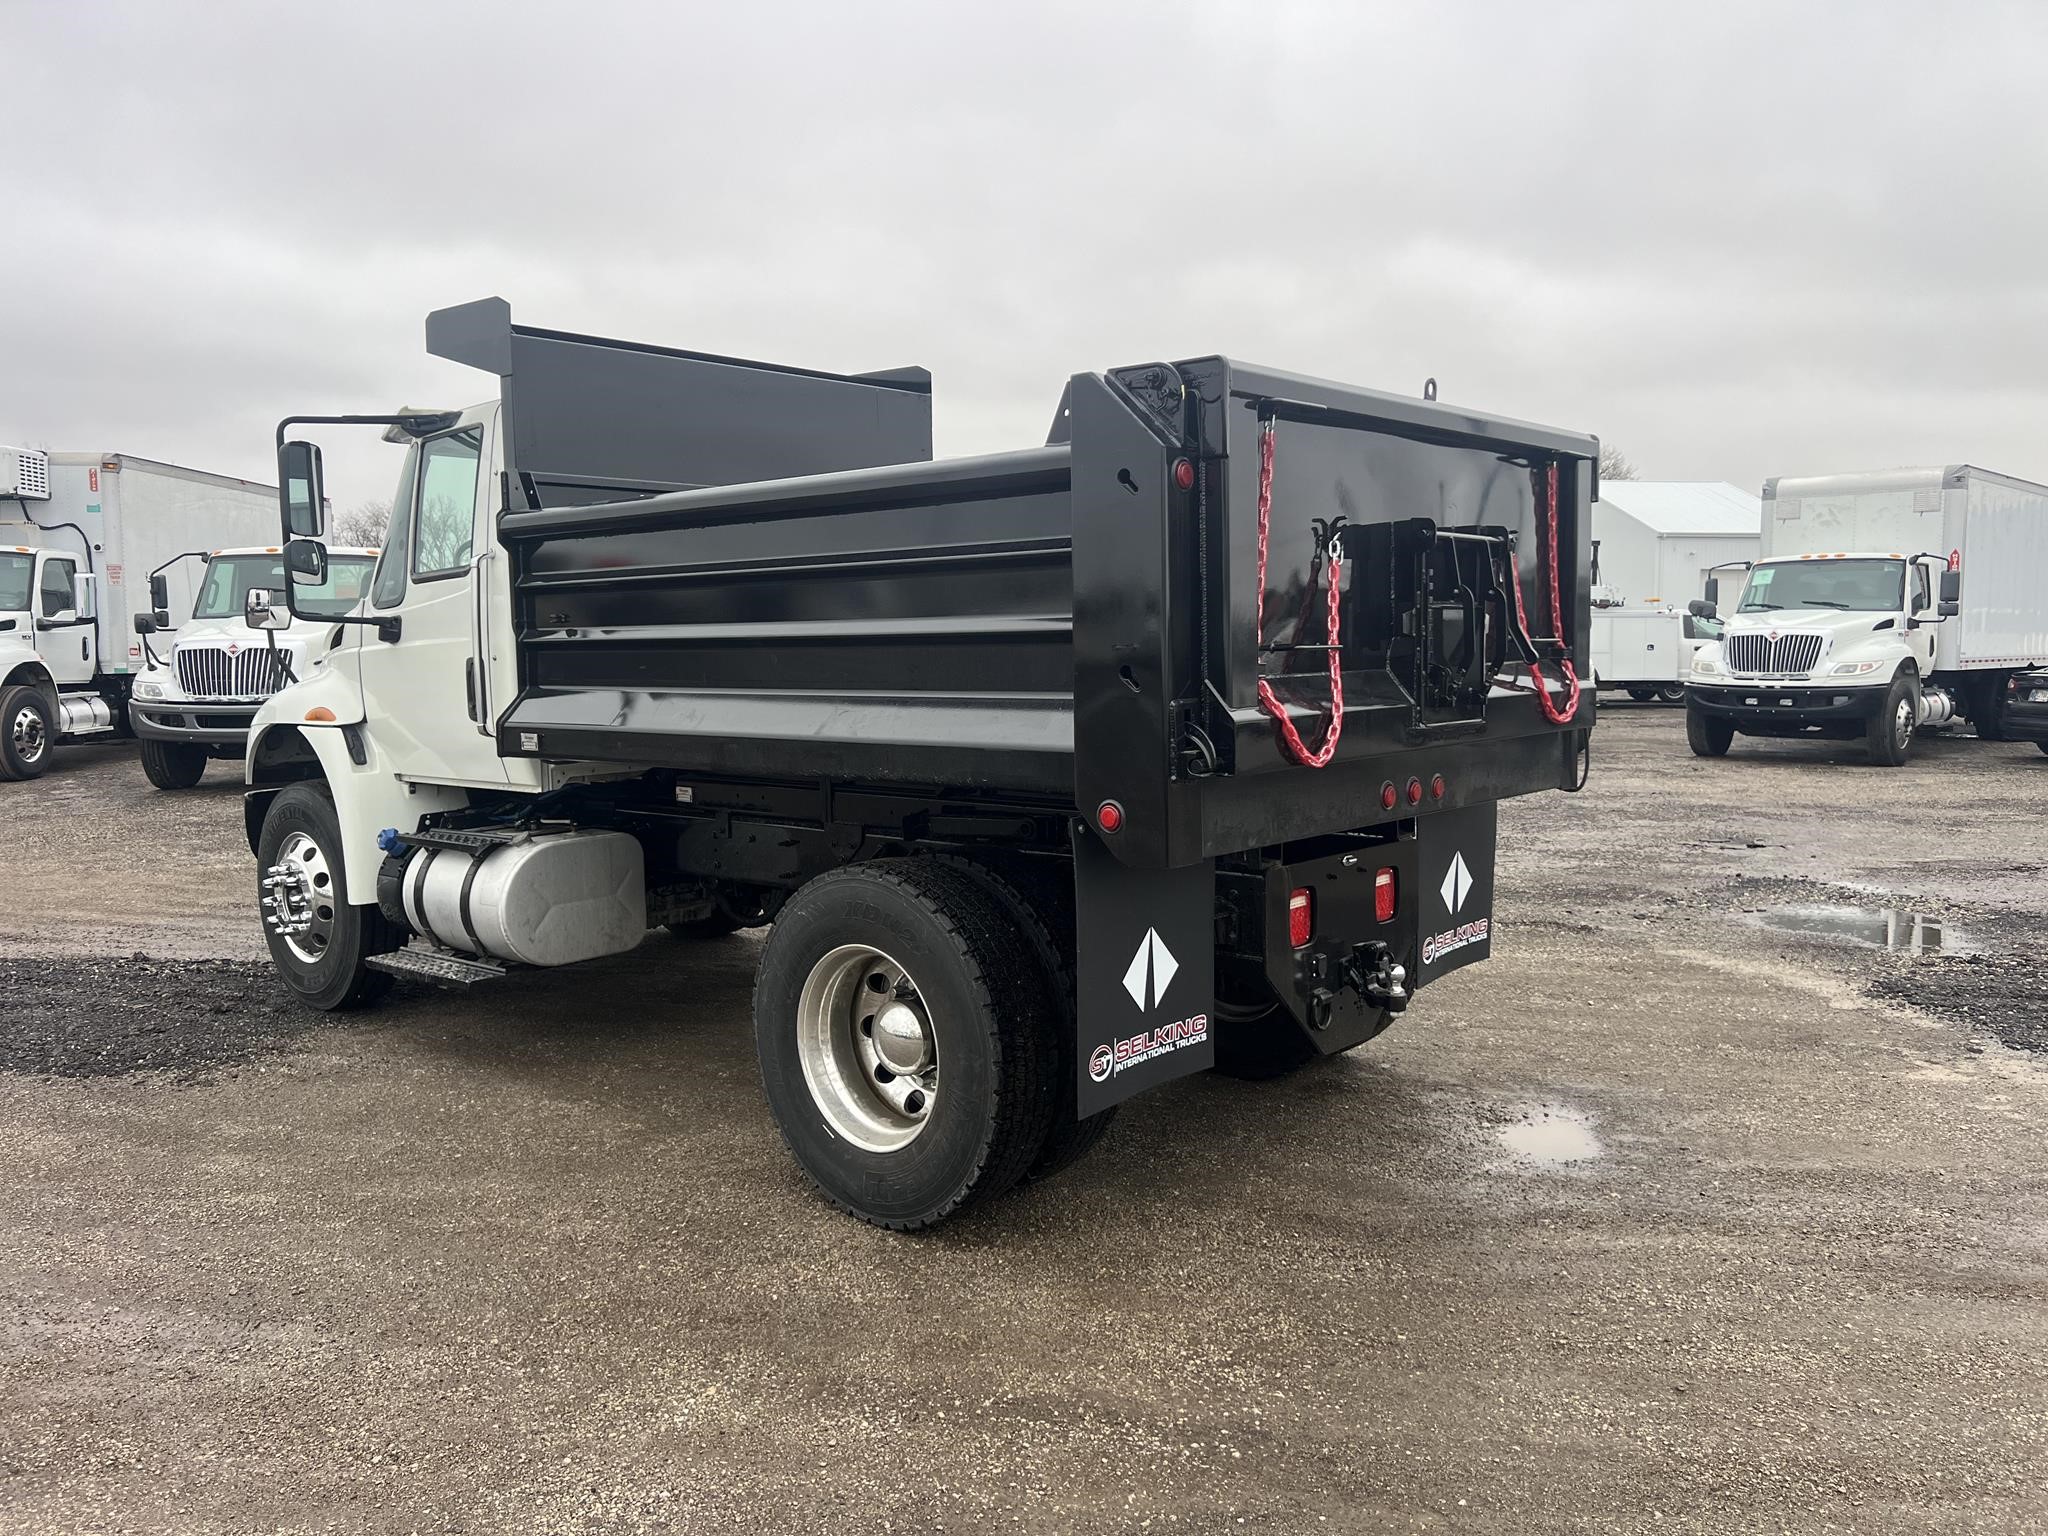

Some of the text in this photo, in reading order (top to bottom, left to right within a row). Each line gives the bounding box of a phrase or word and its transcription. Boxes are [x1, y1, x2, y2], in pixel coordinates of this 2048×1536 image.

[1436, 918, 1488, 950] SELKING
[1116, 1014, 1207, 1062] SELKING
[1116, 1033, 1207, 1073] INTERNATIONAL TRUCKS
